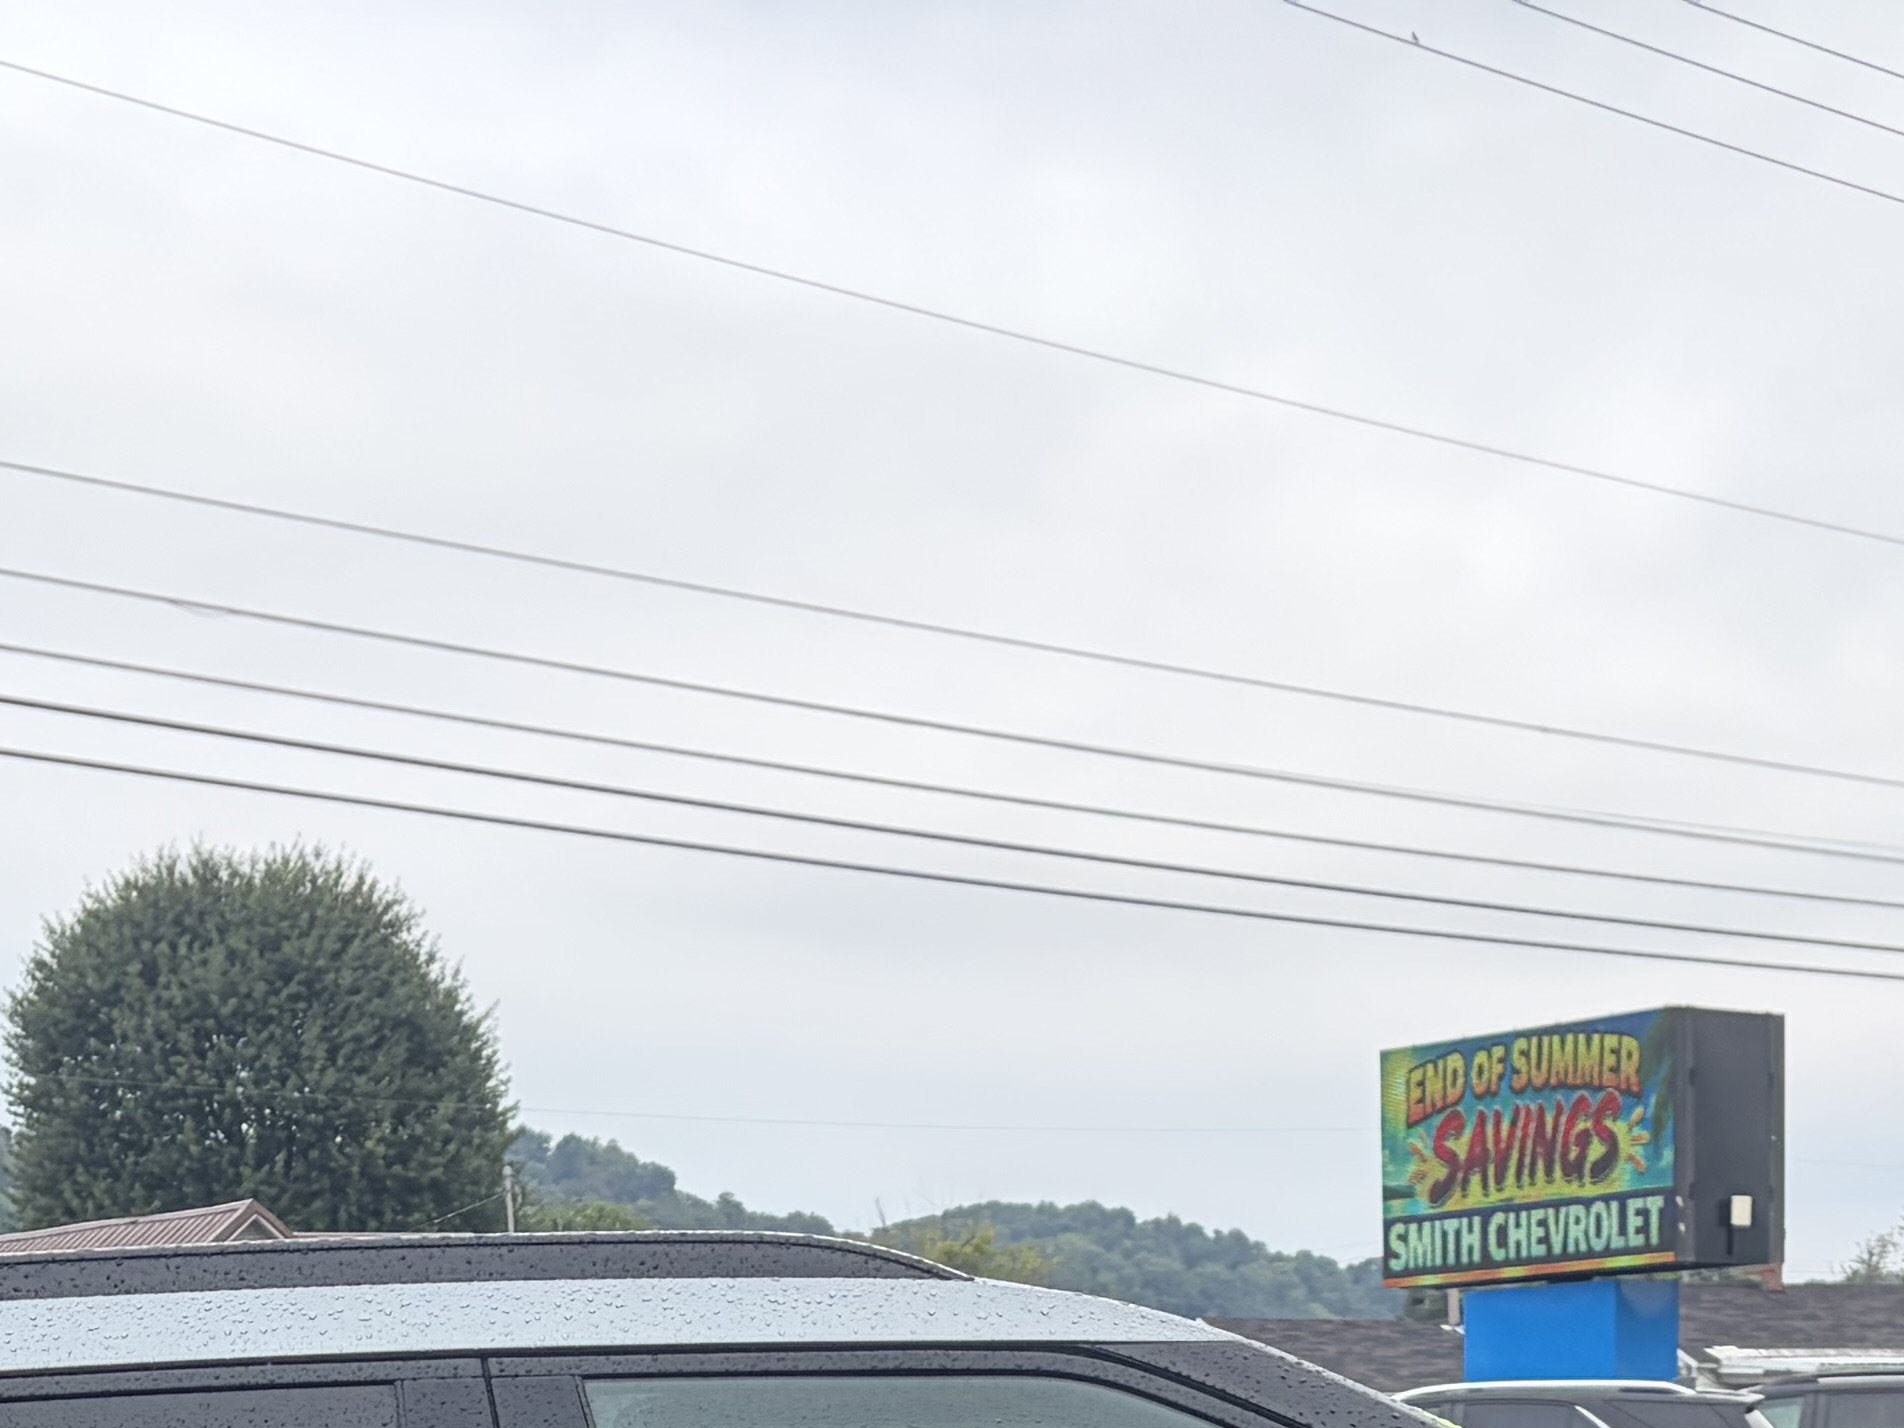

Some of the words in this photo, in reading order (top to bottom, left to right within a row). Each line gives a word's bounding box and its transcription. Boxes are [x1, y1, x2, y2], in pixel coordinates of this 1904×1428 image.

[1407, 1052, 1467, 1129] END
[1471, 1045, 1507, 1096] OF
[1510, 1032, 1642, 1098] SUMMER
[1429, 1089, 1622, 1206] SAVINGS
[1388, 1215, 1482, 1270] SMITH
[1487, 1196, 1665, 1261] CHEVROLET
